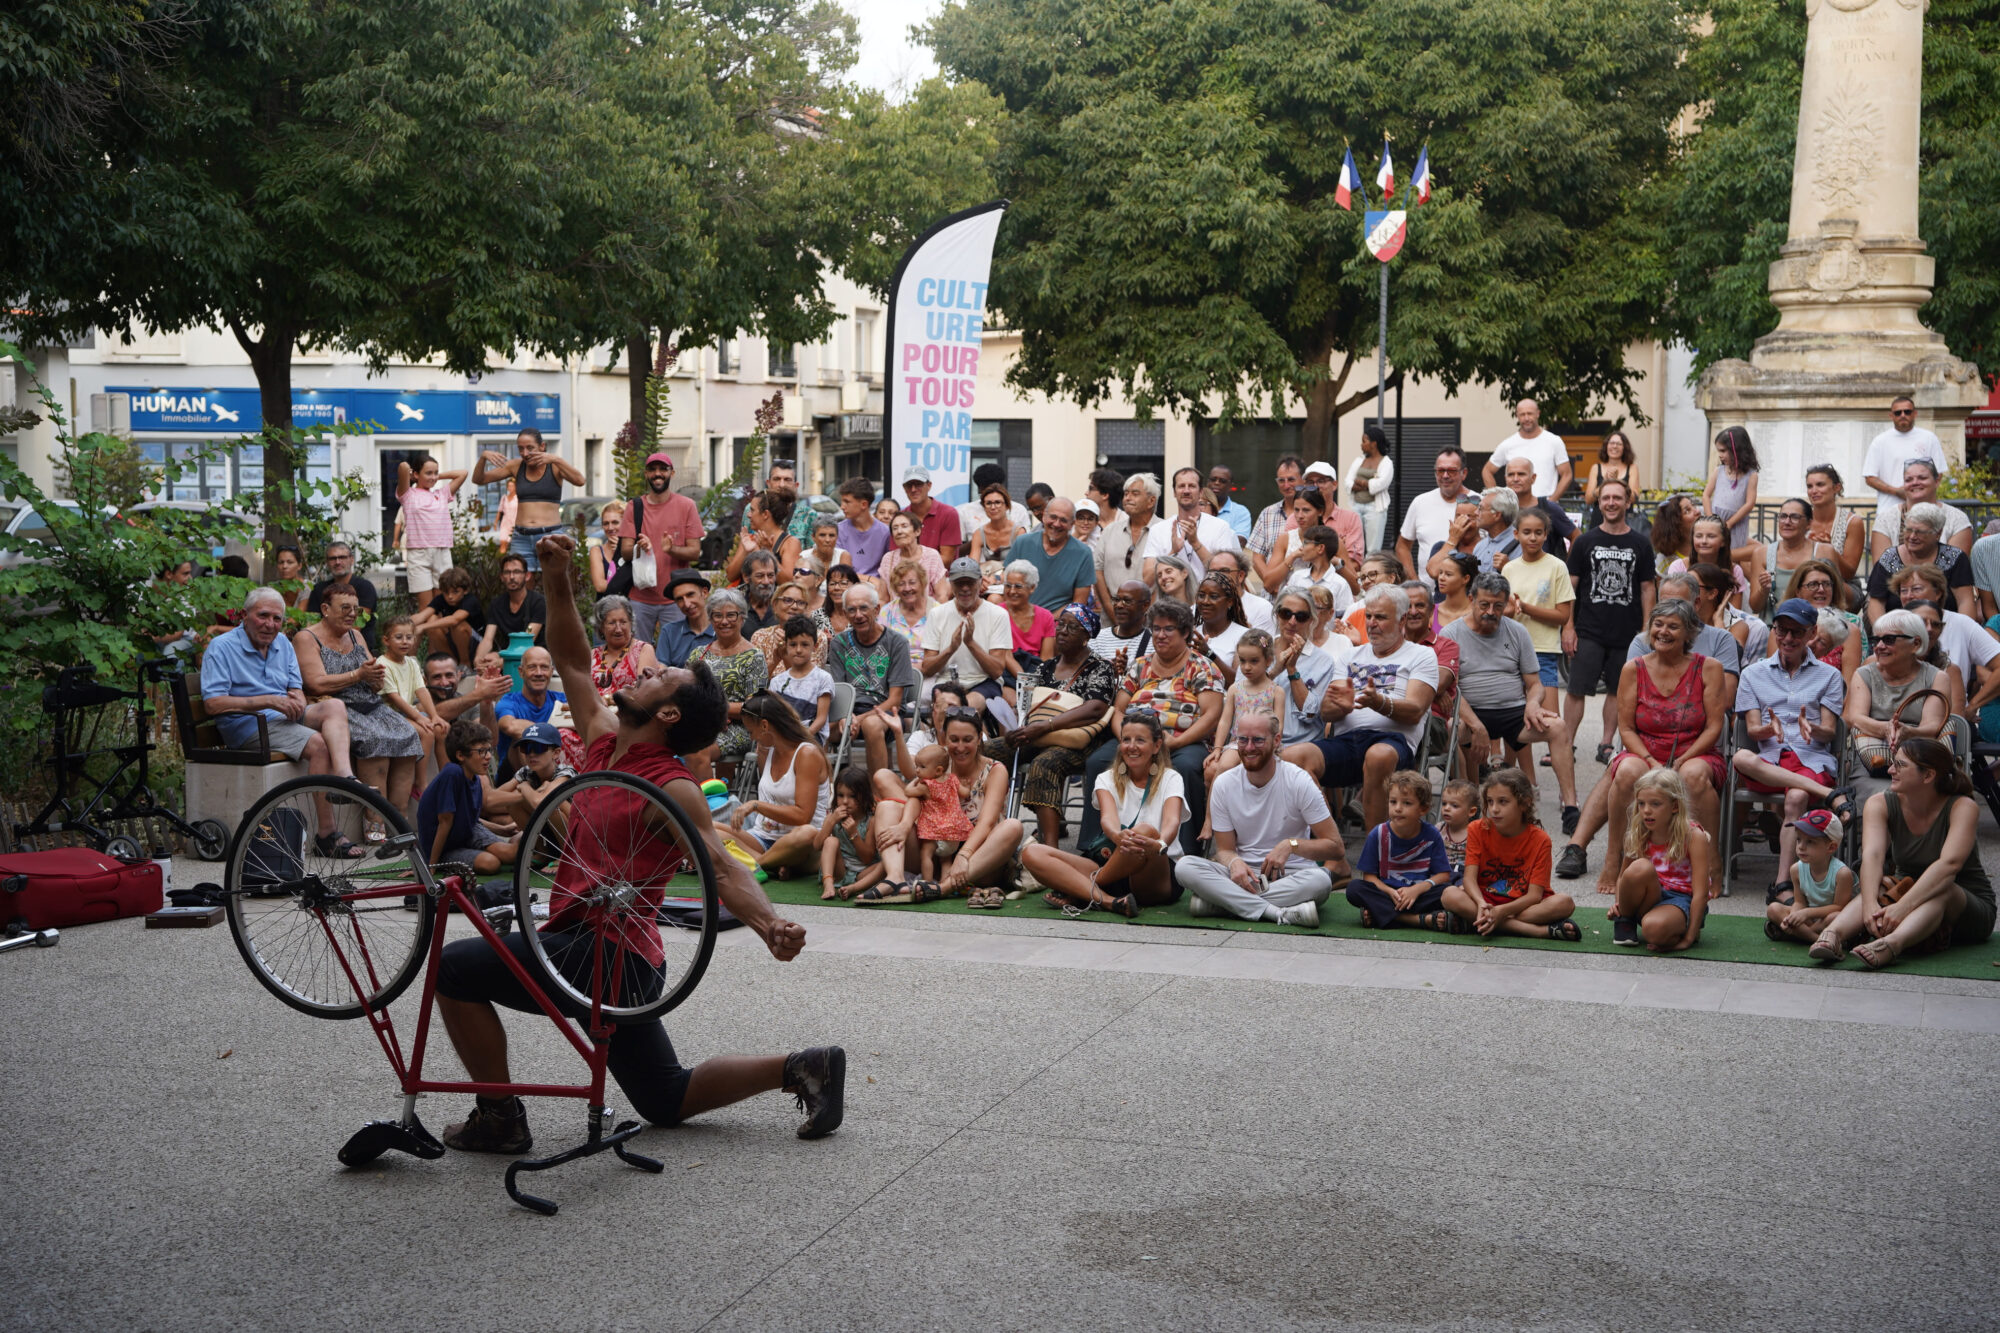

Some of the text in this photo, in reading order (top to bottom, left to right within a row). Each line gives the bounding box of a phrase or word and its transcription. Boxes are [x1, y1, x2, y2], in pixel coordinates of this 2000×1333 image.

[917, 277, 988, 311] CULT
[926, 311, 983, 344] URE
[902, 343, 979, 376] POUR
[132, 396, 206, 413] HUMAN
[476, 400, 508, 415] HUMAN
[904, 376, 976, 408] TOUS
[161, 414, 211, 423] Immobilier
[921, 409, 972, 441] PAR
[905, 442, 971, 472] TOUT
